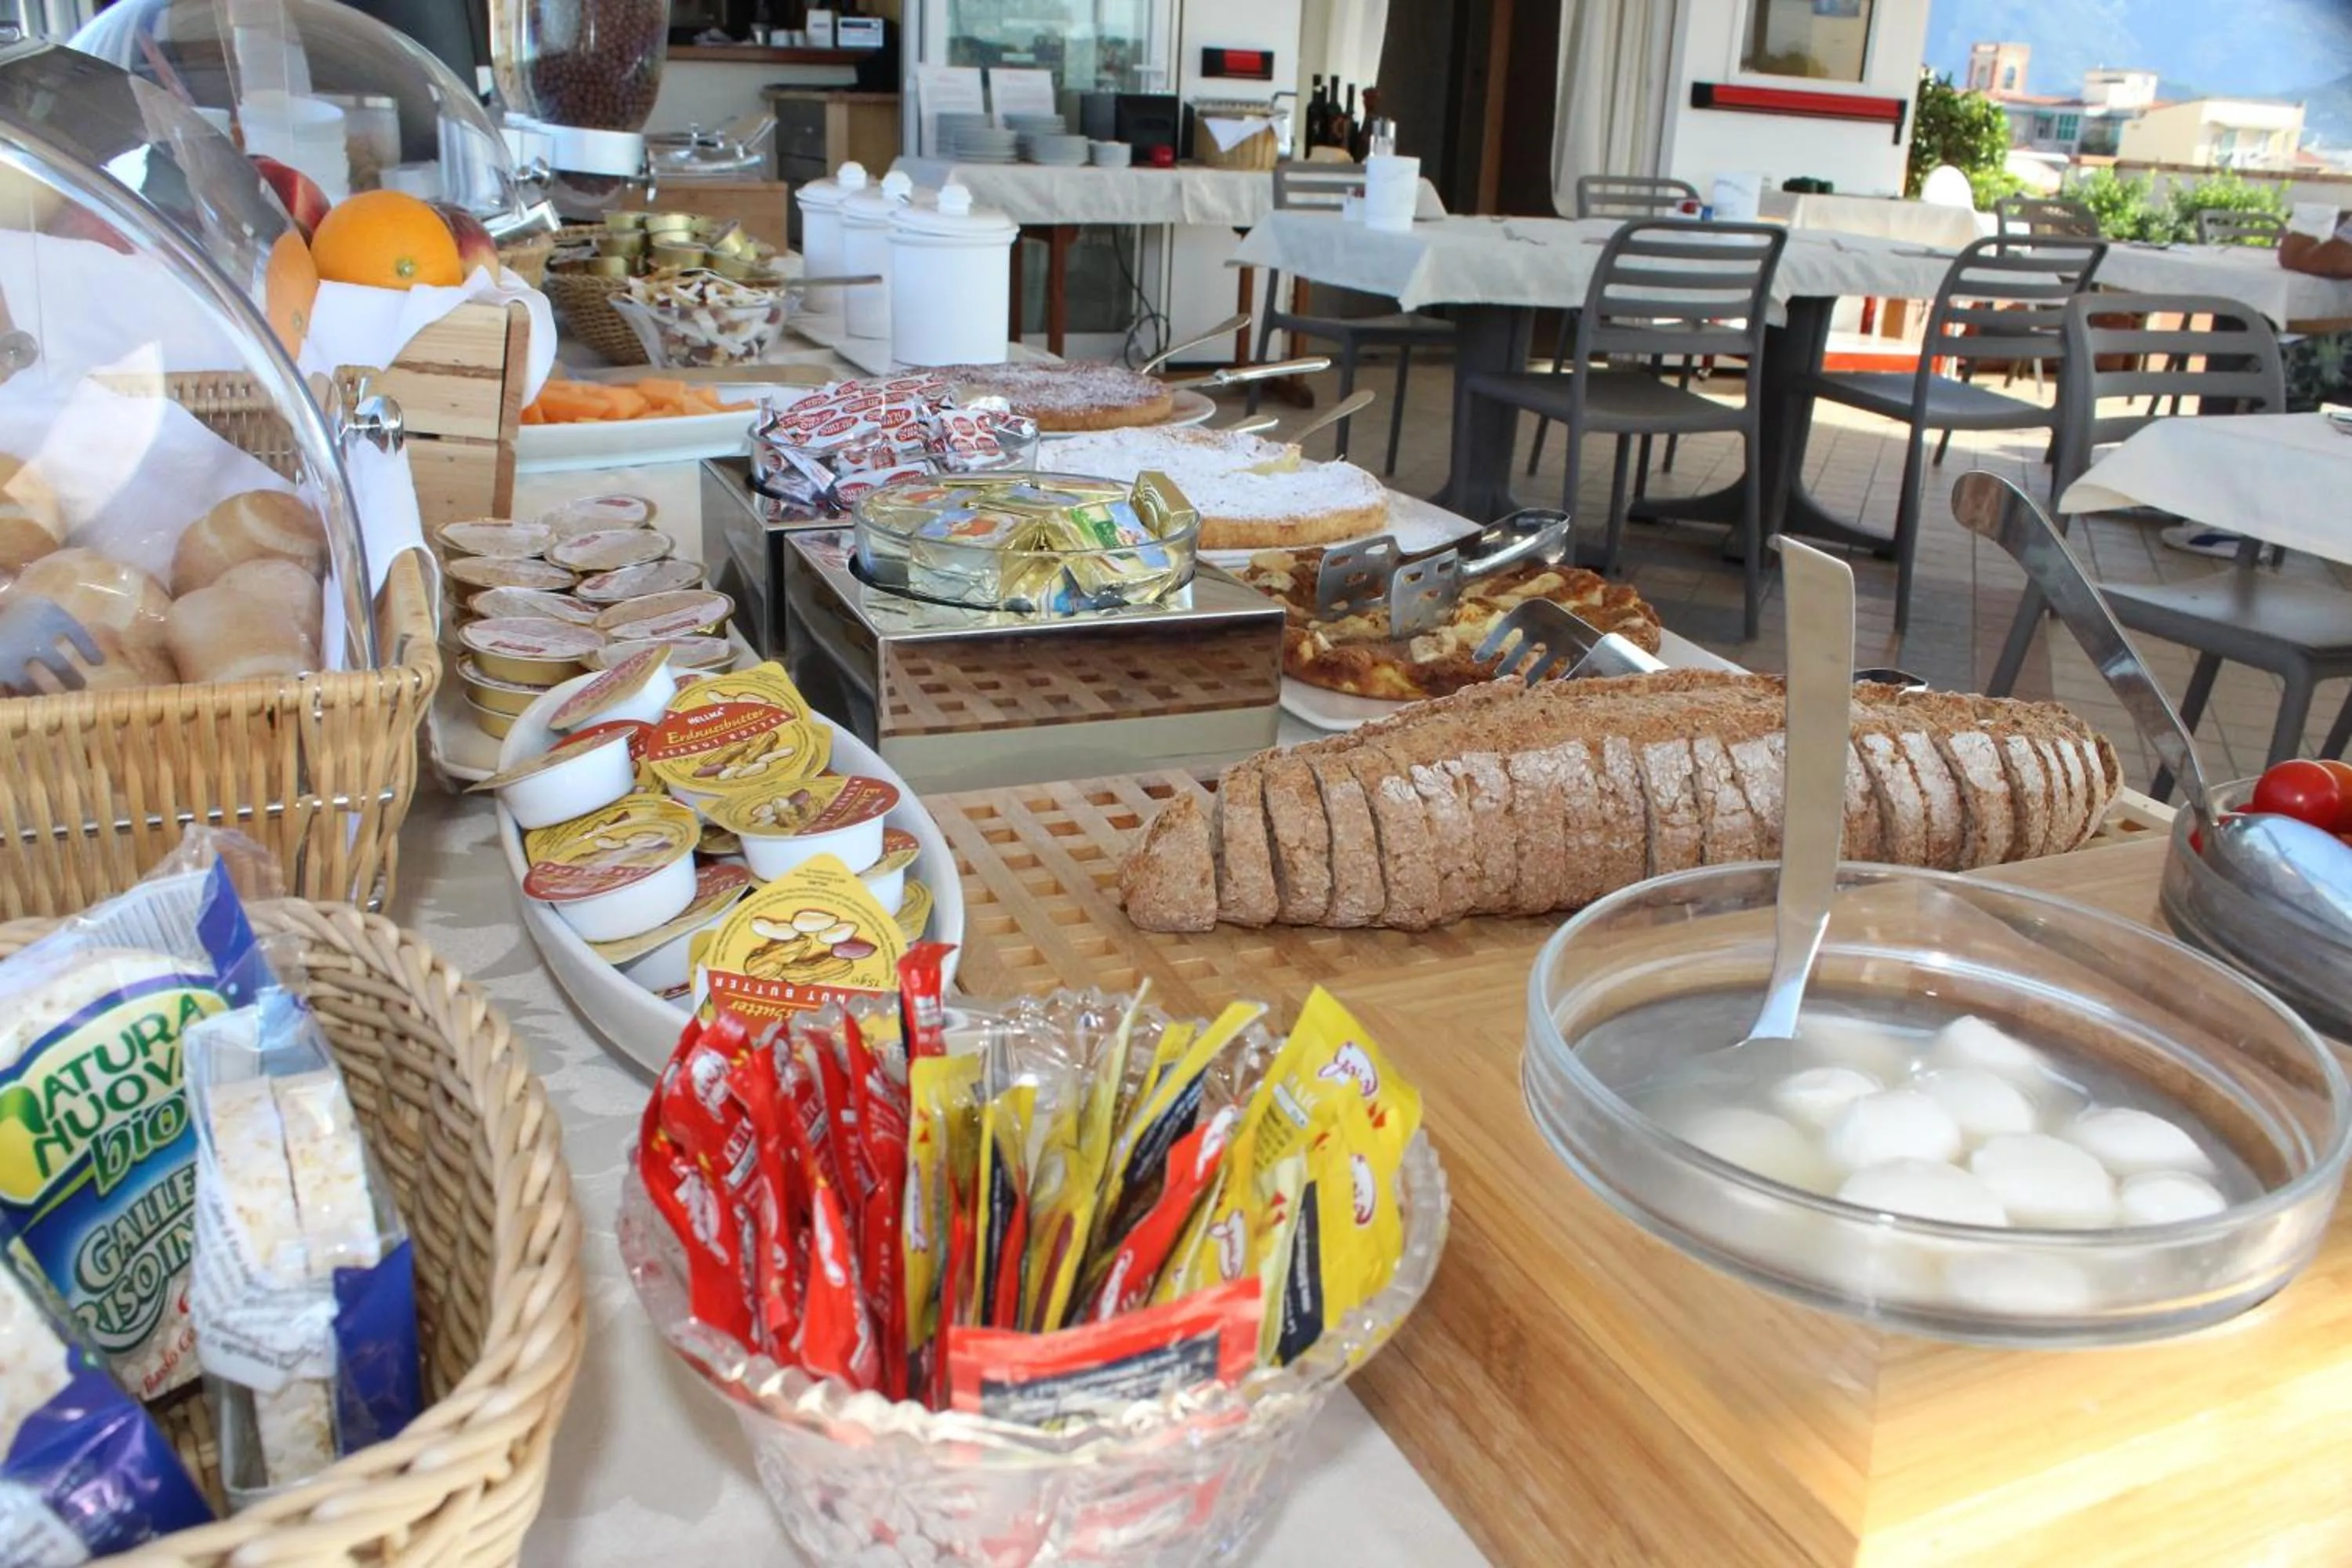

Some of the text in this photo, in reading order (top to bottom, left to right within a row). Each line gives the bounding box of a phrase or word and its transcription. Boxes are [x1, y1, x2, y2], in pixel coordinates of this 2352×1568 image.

[657, 713, 788, 758] PEANUT BUTTER
[666, 708, 766, 744] Erdnussbutter
[687, 707, 724, 726] HELLMA
[714, 977, 847, 1004] NUT BUTTER
[728, 1000, 795, 1022] sbutter
[0, 993, 209, 1134] NATURA
[33, 1046, 183, 1180] NUOV
[89, 1091, 188, 1196] bio
[74, 1163, 196, 1294] GALLE
